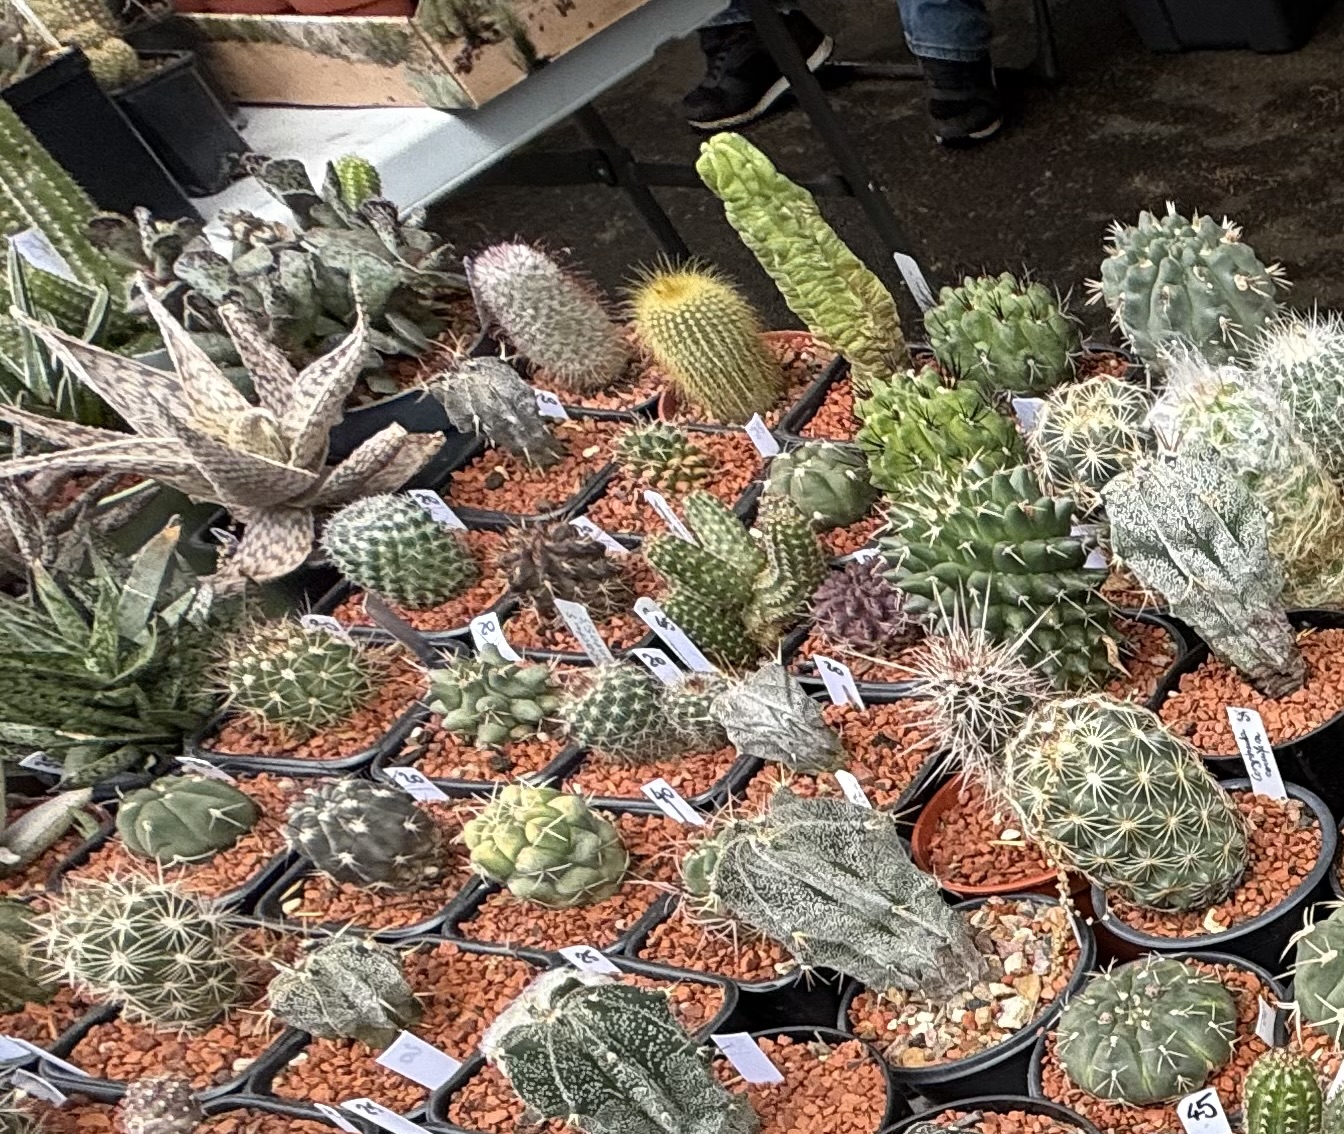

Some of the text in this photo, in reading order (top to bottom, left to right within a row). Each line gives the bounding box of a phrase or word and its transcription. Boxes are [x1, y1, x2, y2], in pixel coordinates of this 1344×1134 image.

[478, 620, 495, 635] 20
[643, 653, 665, 666] 20
[398, 772, 424, 784] 20
[654, 787, 674, 803] 40
[575, 949, 599, 964] 25
[1188, 1092, 1217, 1121] 45
